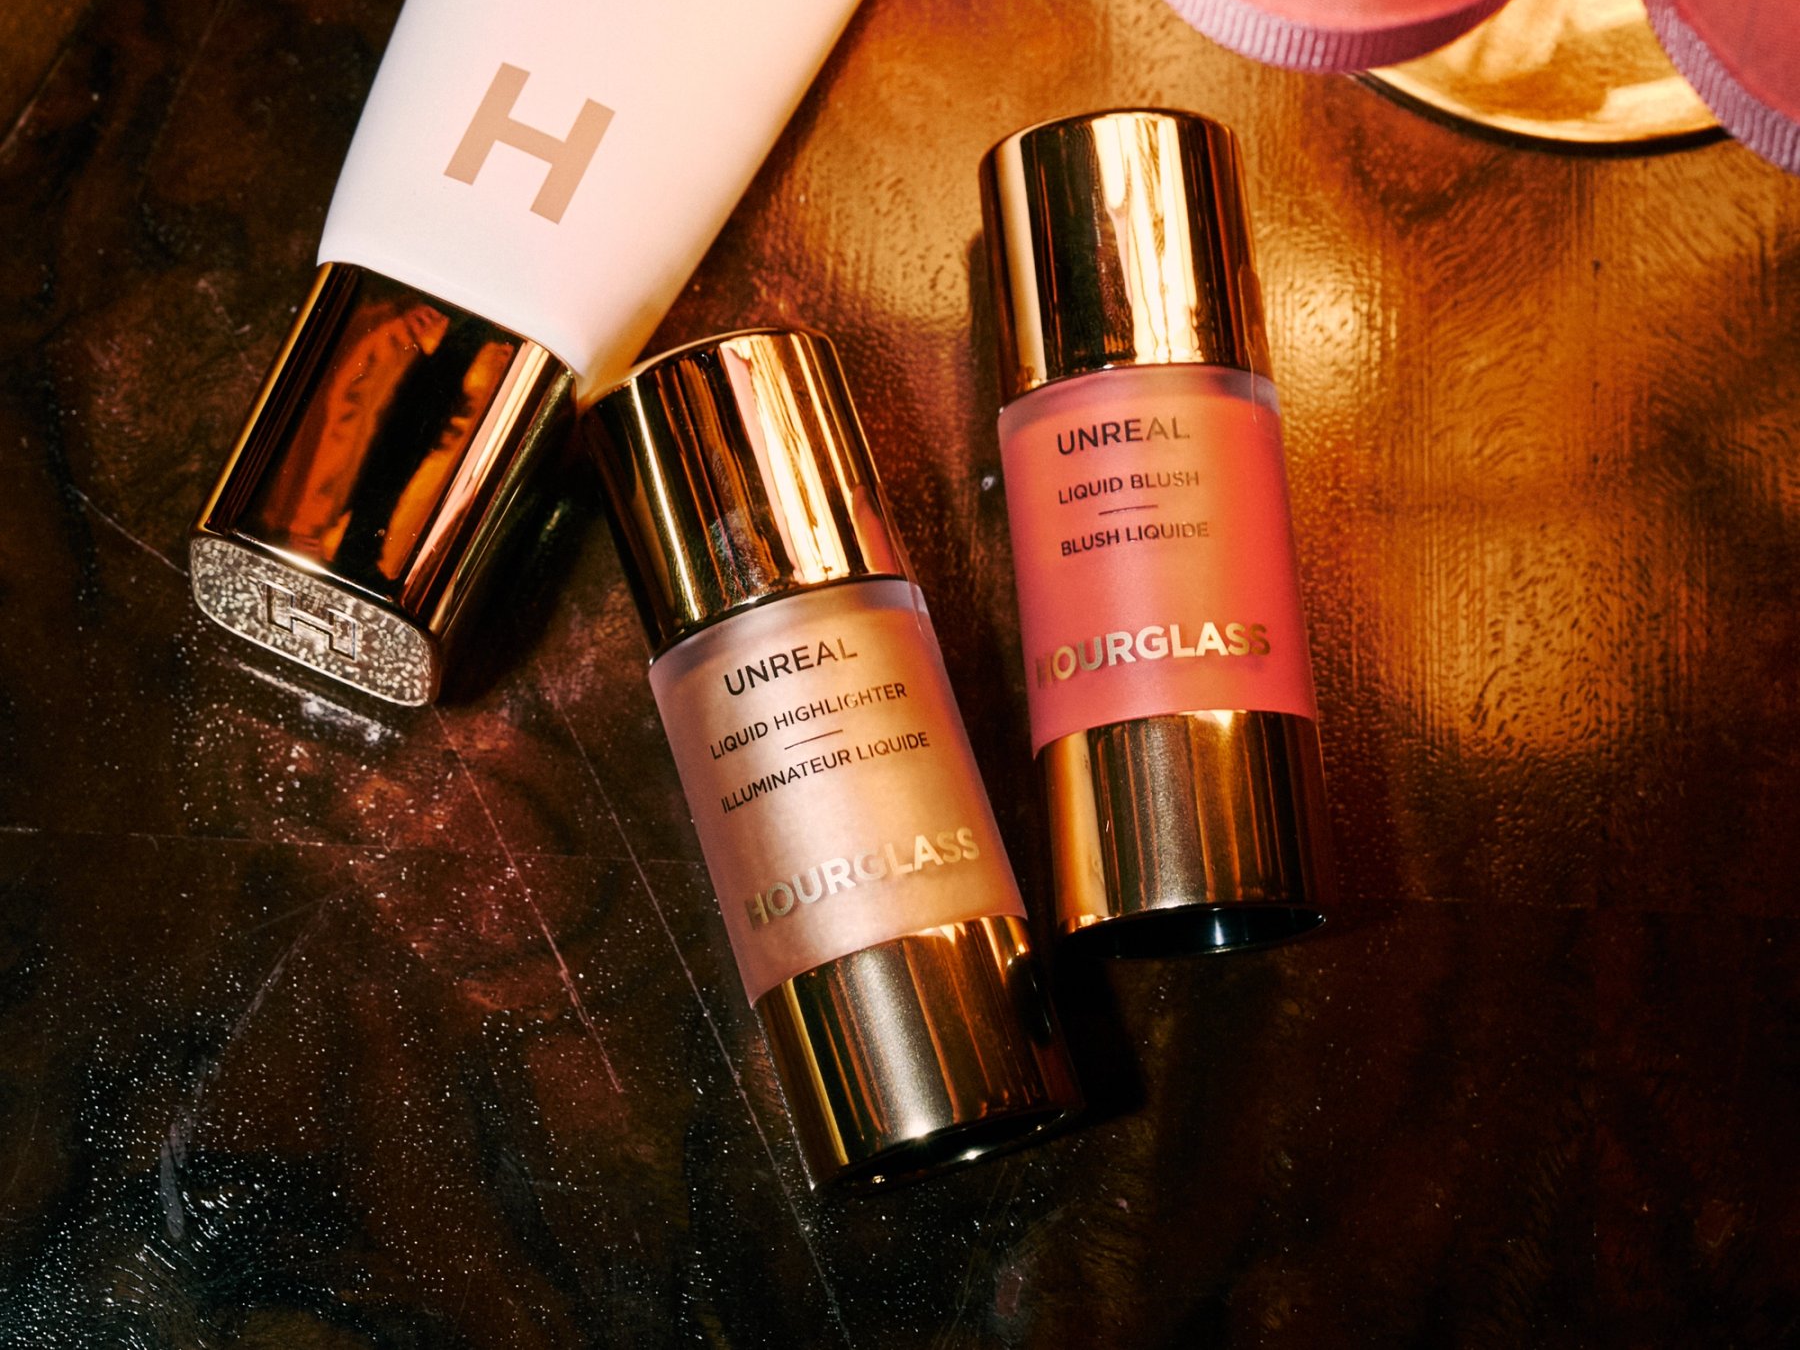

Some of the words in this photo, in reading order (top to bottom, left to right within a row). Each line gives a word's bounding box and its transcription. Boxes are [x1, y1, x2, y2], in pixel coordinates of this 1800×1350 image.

[443, 61, 616, 225] H
[1057, 416, 1191, 456] UNREAL
[1058, 477, 1124, 505] LIQUID
[1130, 471, 1200, 490] BLUSH
[1060, 529, 1120, 557] BLUSH
[1125, 521, 1210, 543] LIQUIDE
[723, 638, 858, 696] UNREAL
[710, 721, 769, 760] LIQUID
[773, 682, 908, 731] HIGHLIGHTER
[721, 749, 852, 814] ILLUMINATEUR
[855, 731, 931, 761] LIQUIDE
[745, 826, 981, 930] HOURGLASS
